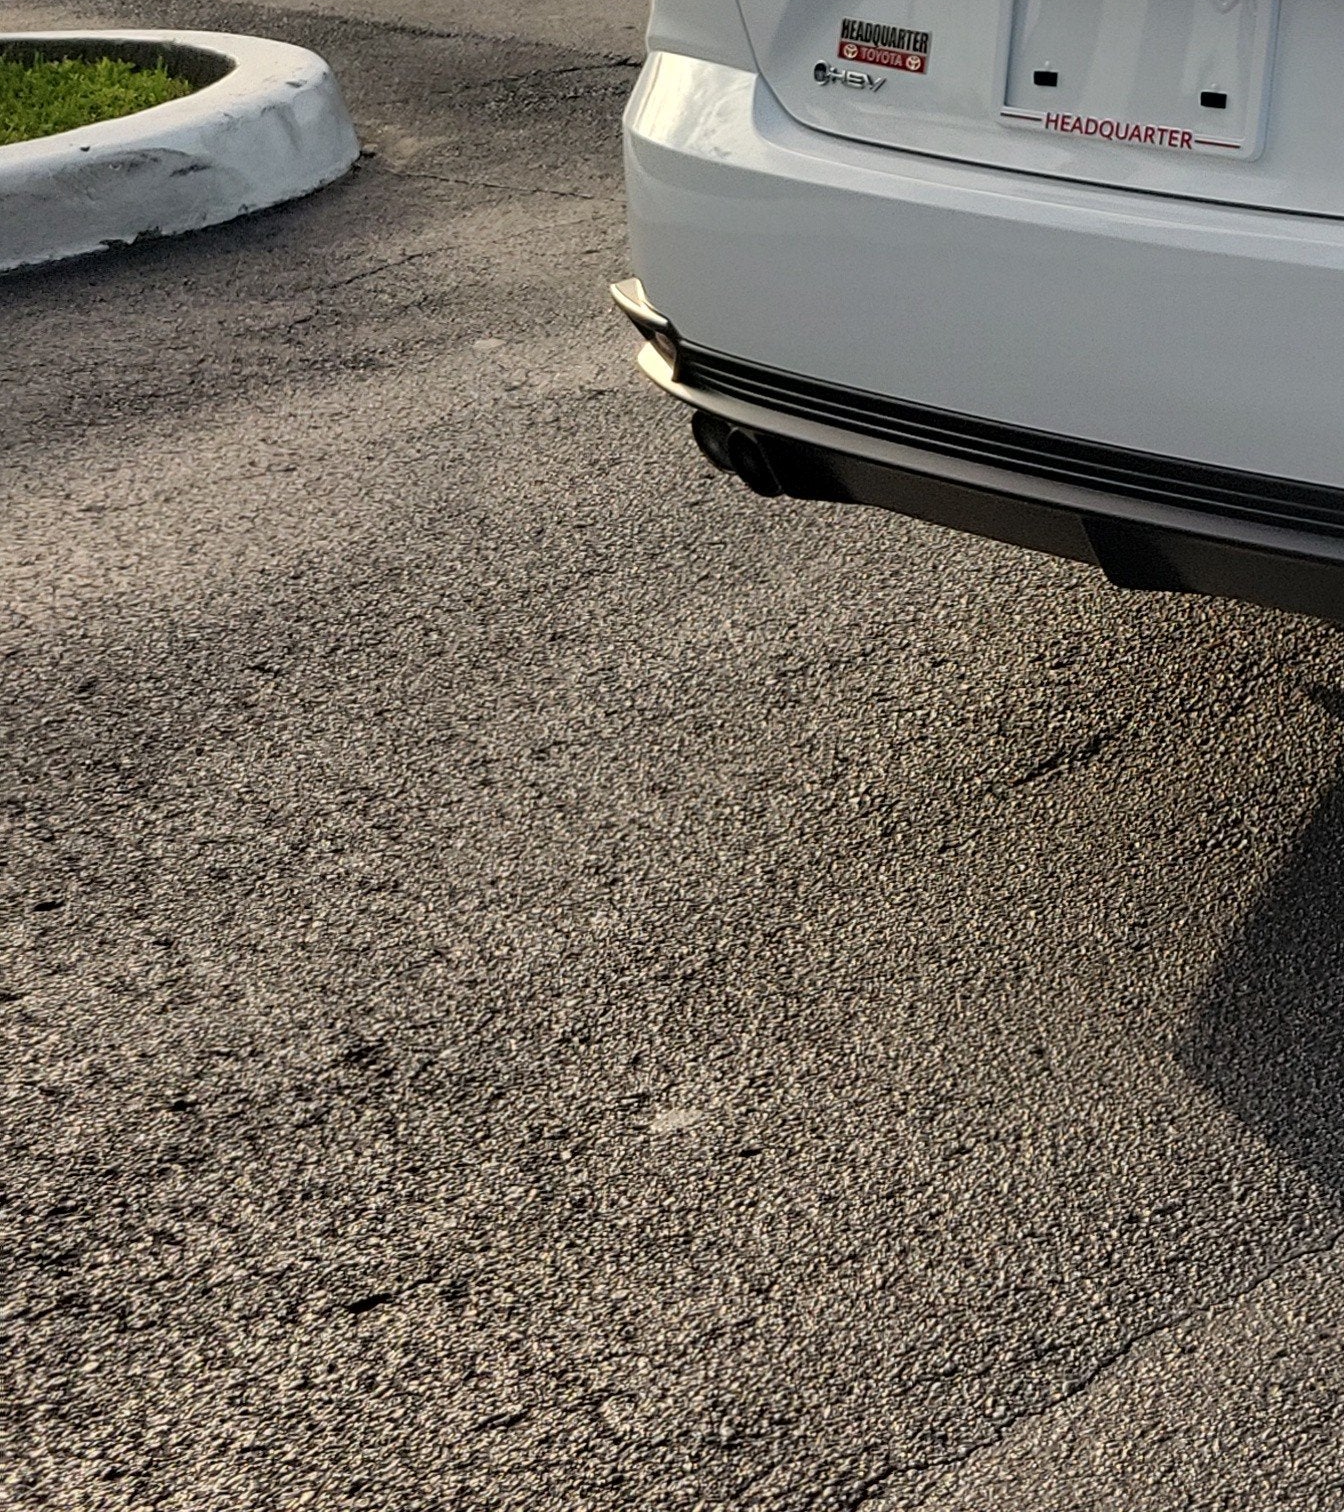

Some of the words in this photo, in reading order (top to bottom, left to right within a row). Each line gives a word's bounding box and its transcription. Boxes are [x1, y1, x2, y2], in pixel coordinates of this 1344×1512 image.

[841, 17, 929, 54] HEADQUARTER
[860, 47, 903, 67] TOYOTA
[1045, 112, 1193, 150] HEADQUARTER
